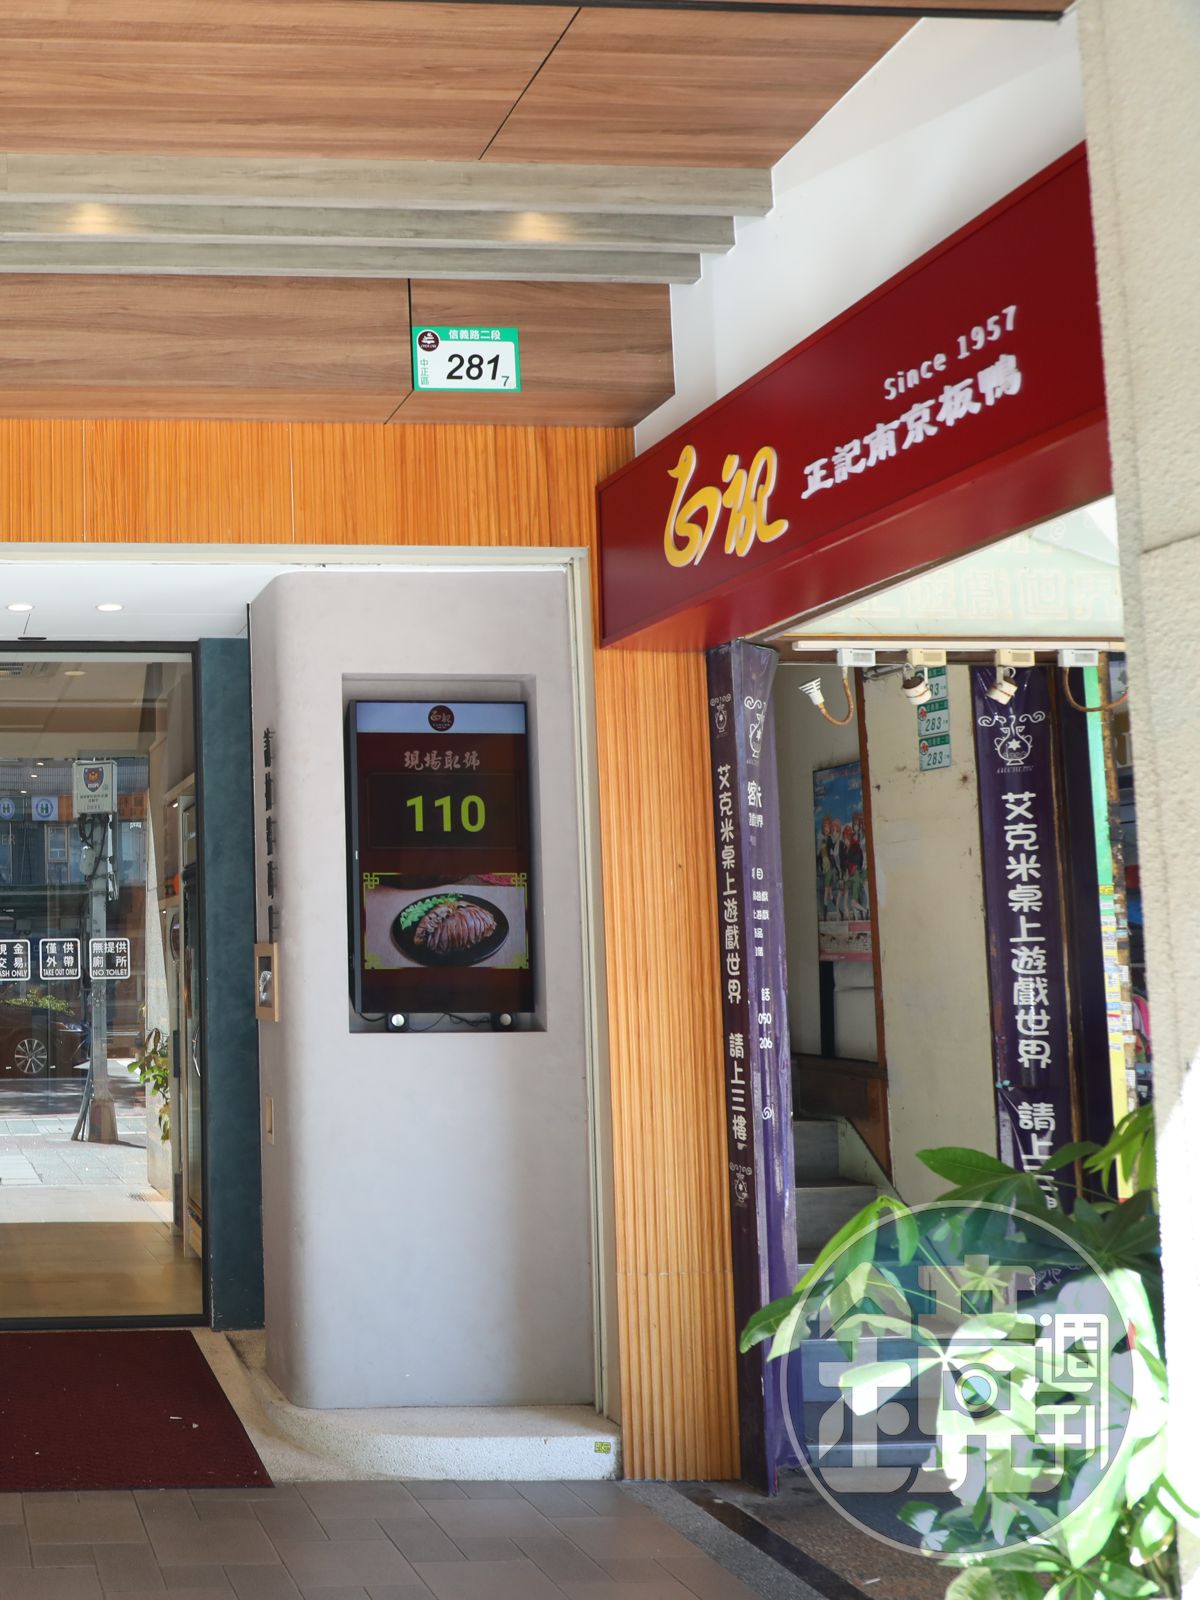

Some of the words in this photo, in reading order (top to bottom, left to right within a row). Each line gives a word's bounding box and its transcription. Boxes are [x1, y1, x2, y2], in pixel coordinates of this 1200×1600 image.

[448, 329, 501, 340] 信義路二段
[884, 352, 947, 400] Since
[956, 305, 1017, 360] 1957
[446, 353, 500, 380] 281
[501, 375, 510, 387] 7
[800, 353, 1023, 499] 正記南京板鴨
[925, 716, 942, 732] 283
[404, 750, 480, 771] 現場取號
[927, 751, 943, 766] 283
[406, 795, 487, 833] 110
[717, 763, 743, 1005] 艾克米桌上遊戲世界
[1001, 791, 1052, 1069] 艾克米桌上遊戲世界
[46, 942, 74, 954] 僅供
[92, 942, 127, 954] 無提供
[46, 956, 74, 967] 外帶
[11, 969, 28, 977] ONLY
[43, 968, 54, 976] TAKE
[55, 968, 65, 976] OUT
[65, 968, 78, 976] ONLY
